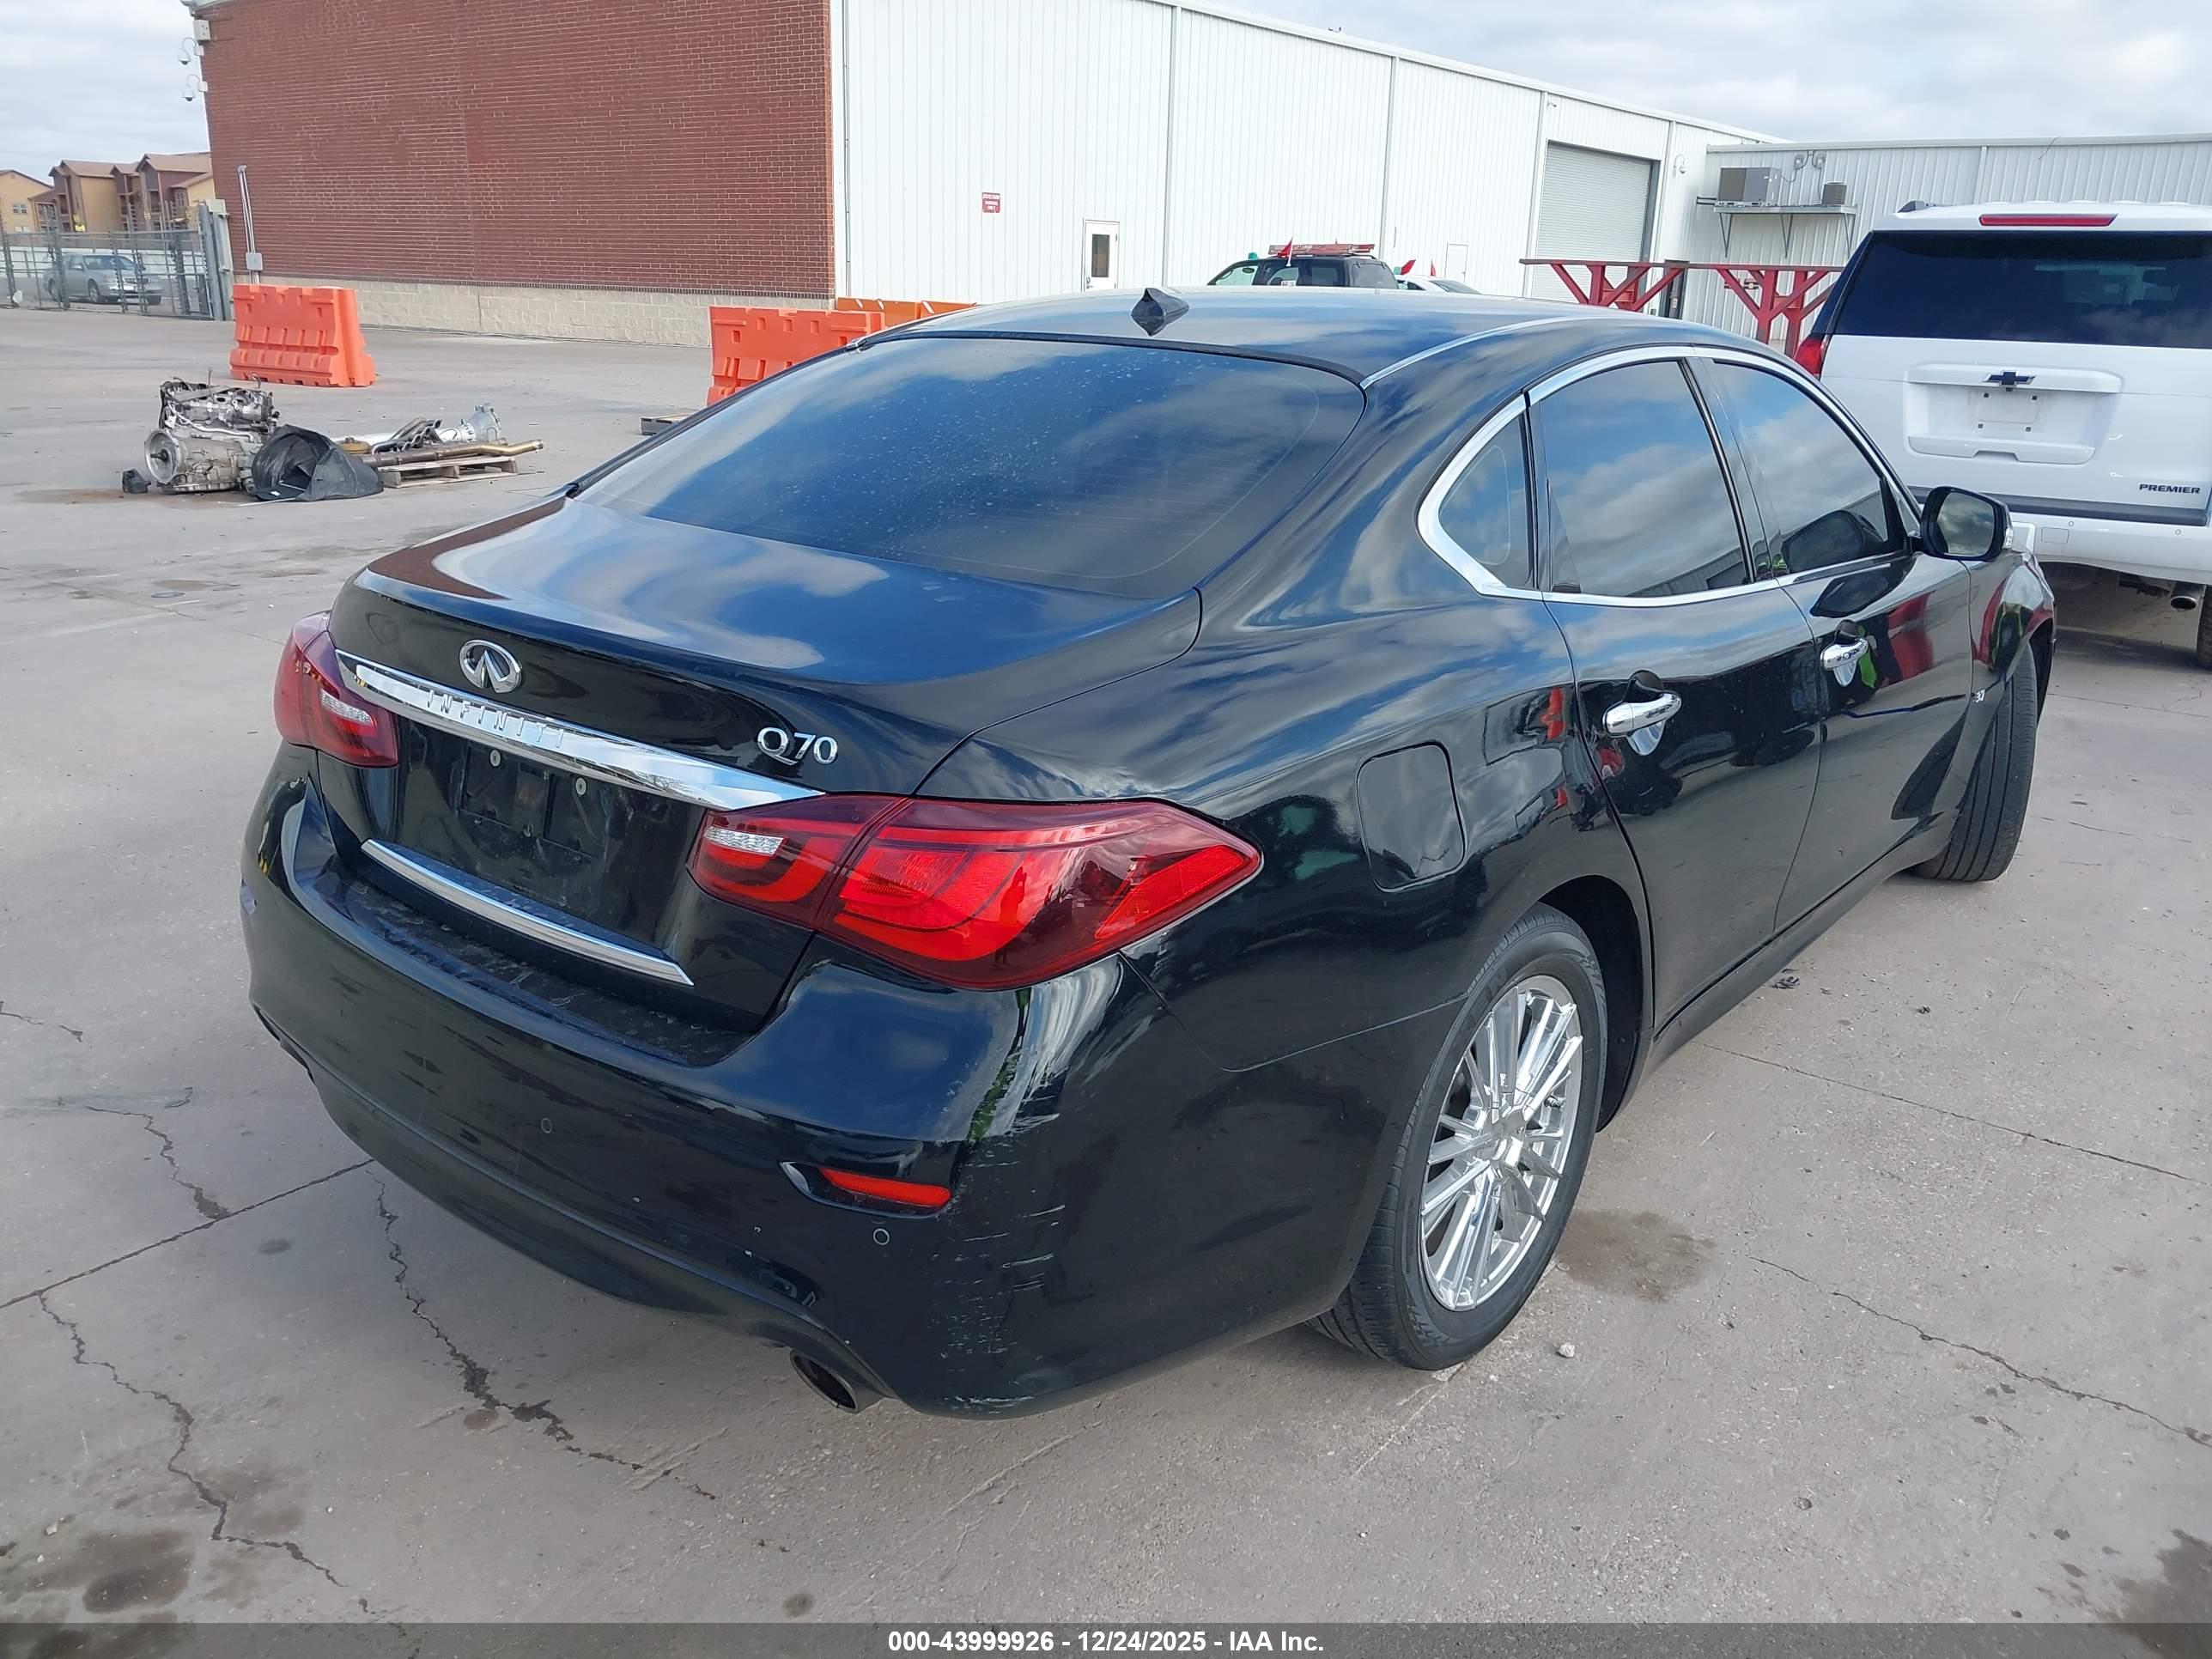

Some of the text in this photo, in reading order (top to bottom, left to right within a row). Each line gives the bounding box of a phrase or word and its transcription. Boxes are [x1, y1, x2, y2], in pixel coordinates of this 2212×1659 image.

[2139, 483, 2201, 494] PREMIER
[426, 690, 564, 749] INFINITI
[757, 726, 838, 766] Q70
